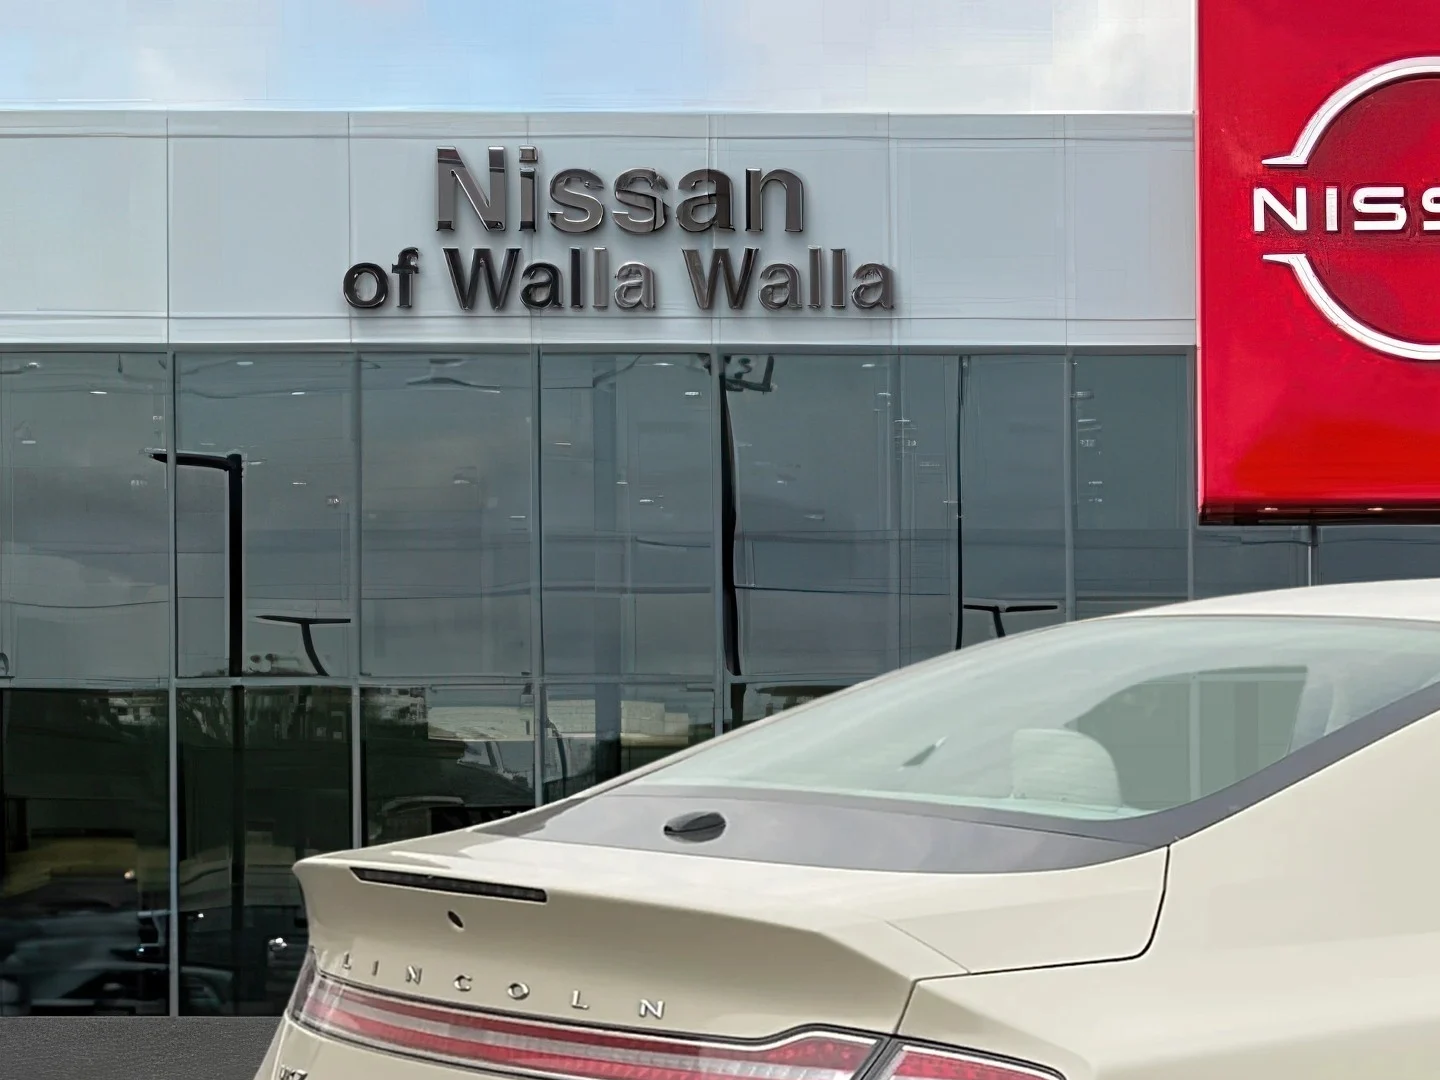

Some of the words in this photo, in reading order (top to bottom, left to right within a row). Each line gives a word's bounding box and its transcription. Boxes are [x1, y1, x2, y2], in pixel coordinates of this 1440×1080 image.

[436, 145, 804, 233] Nissan
[342, 246, 421, 309] of
[442, 246, 656, 310] Walla
[681, 246, 896, 310] Walla
[340, 951, 666, 1019] LINCOLN
